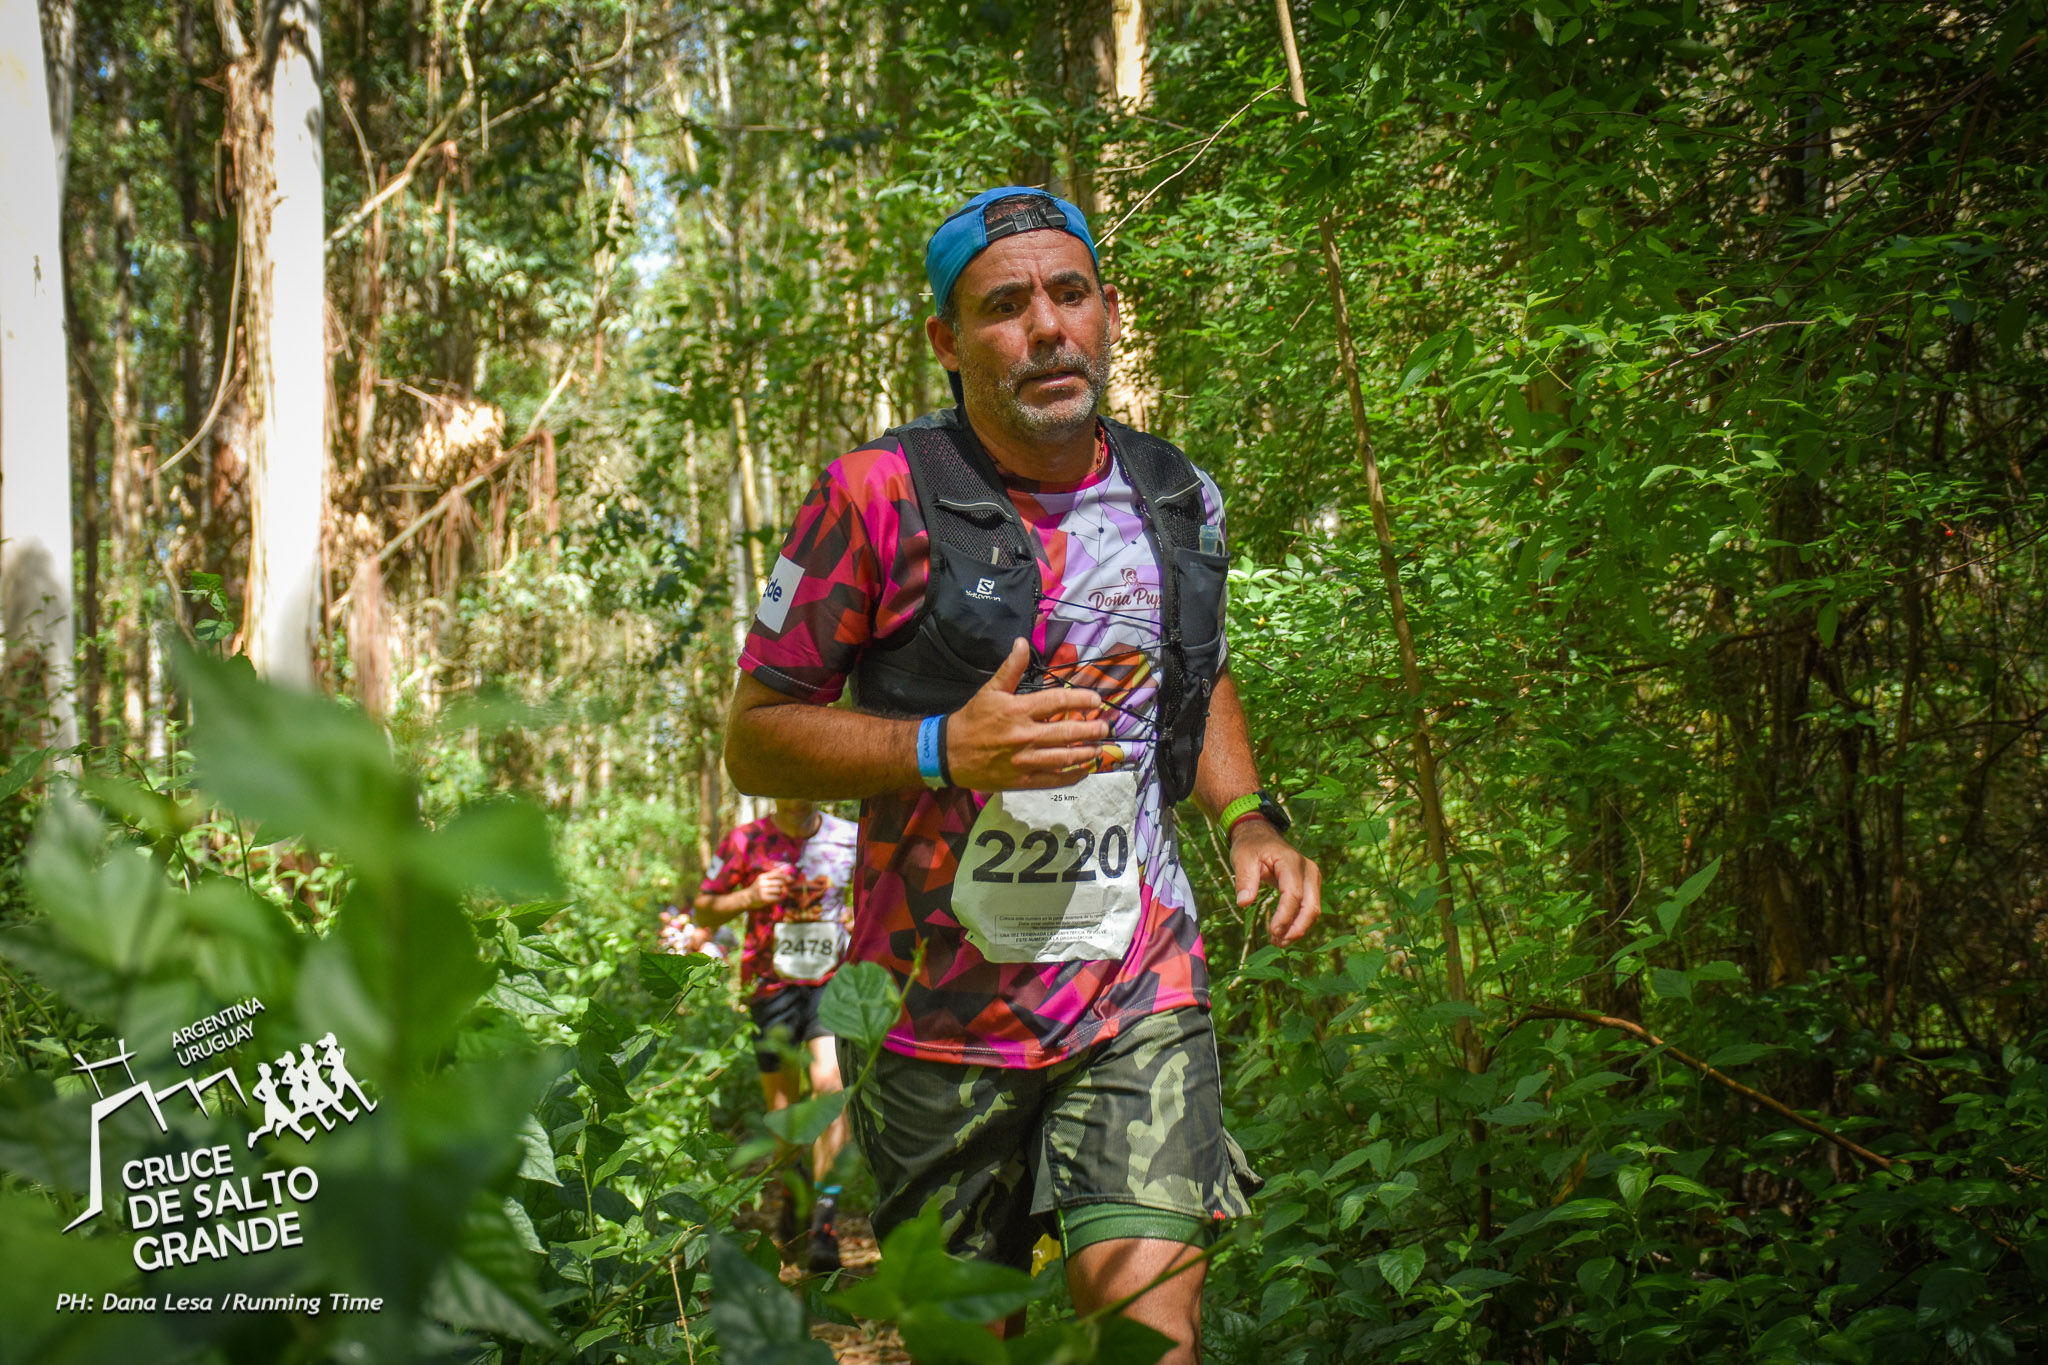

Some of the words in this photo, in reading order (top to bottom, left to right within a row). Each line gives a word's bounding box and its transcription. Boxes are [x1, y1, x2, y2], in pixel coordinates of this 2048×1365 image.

[1088, 591, 1132, 610] Doña
[972, 825, 1129, 884] 2220
[780, 938, 833, 956] 2478
